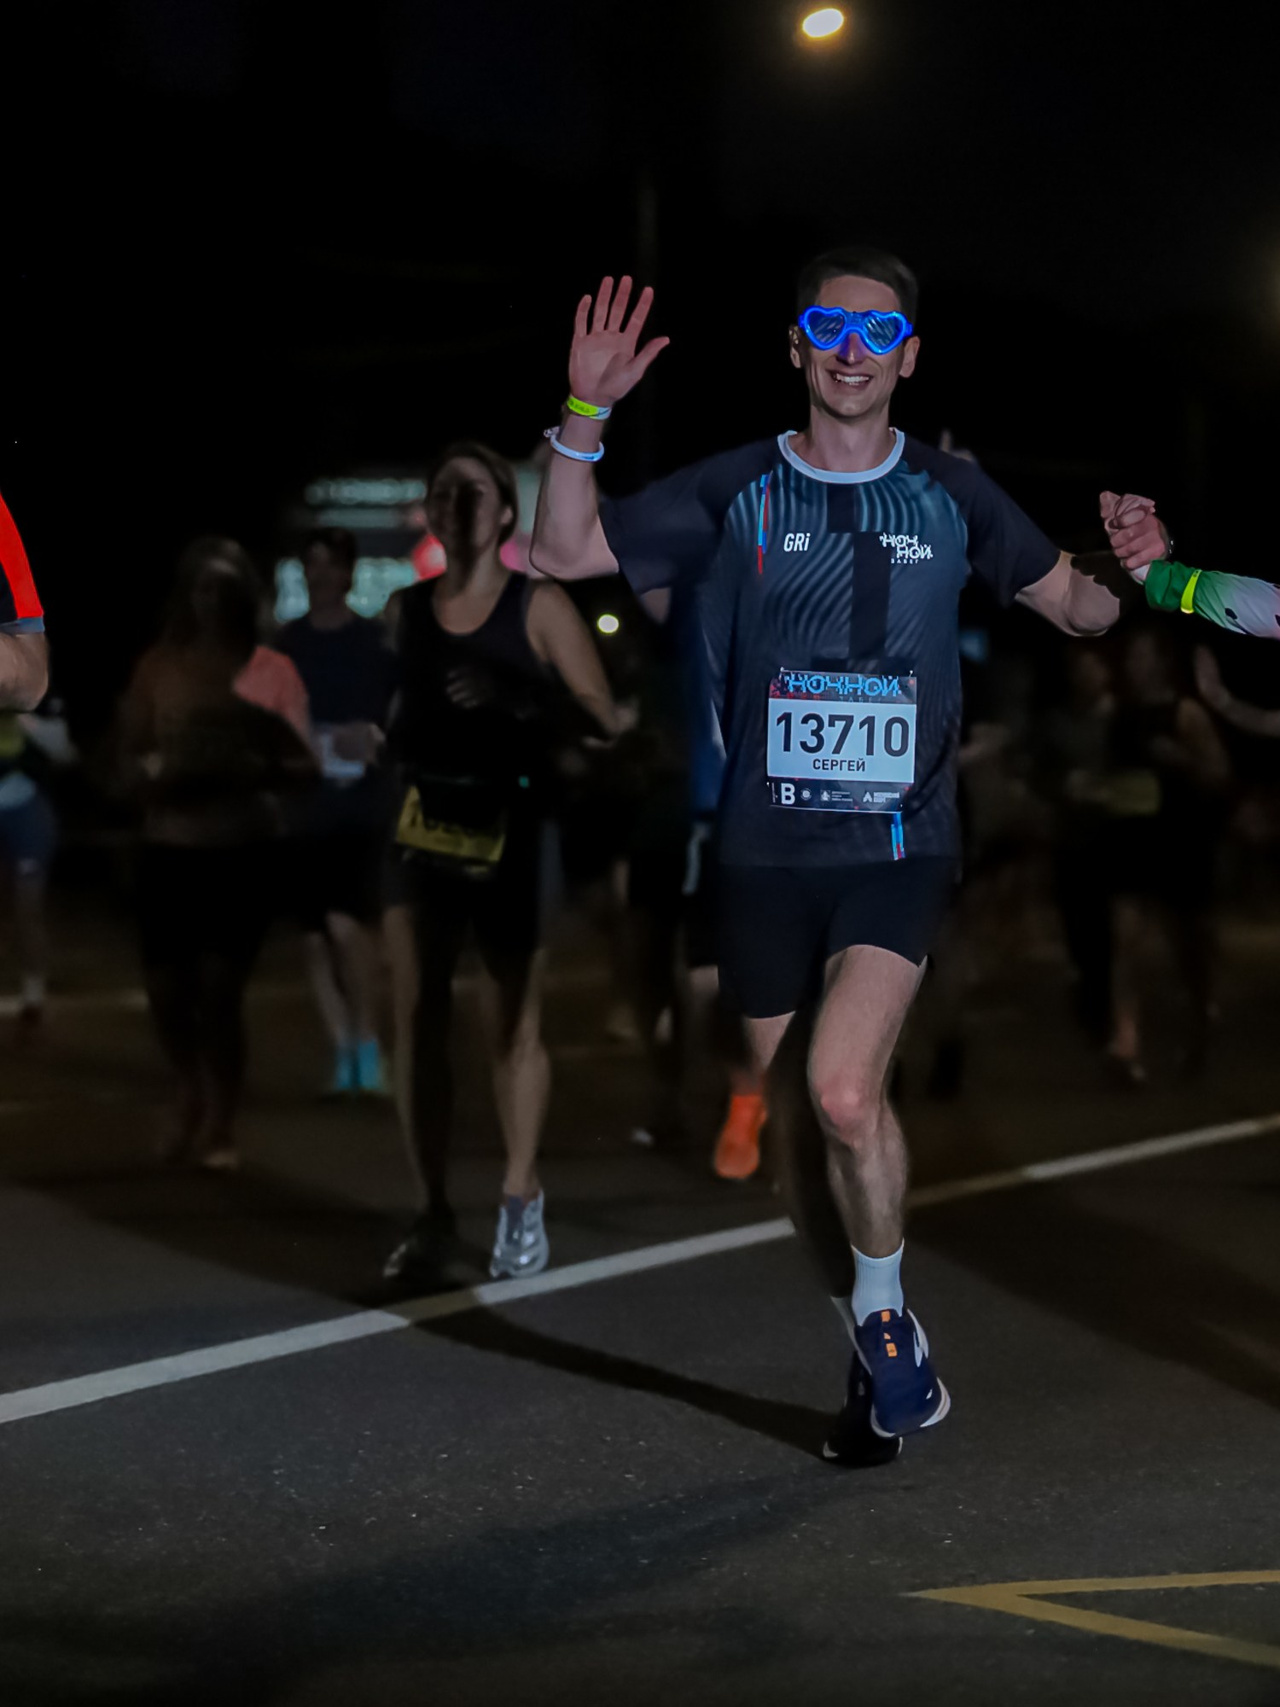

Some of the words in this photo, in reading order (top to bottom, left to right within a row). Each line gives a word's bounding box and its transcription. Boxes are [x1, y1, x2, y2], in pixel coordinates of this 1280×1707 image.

[783, 532, 811, 552] GRi
[785, 674, 902, 697] НОЧНОЙ
[776, 711, 910, 758] 13710
[812, 757, 866, 772] СЕРГЕЙ
